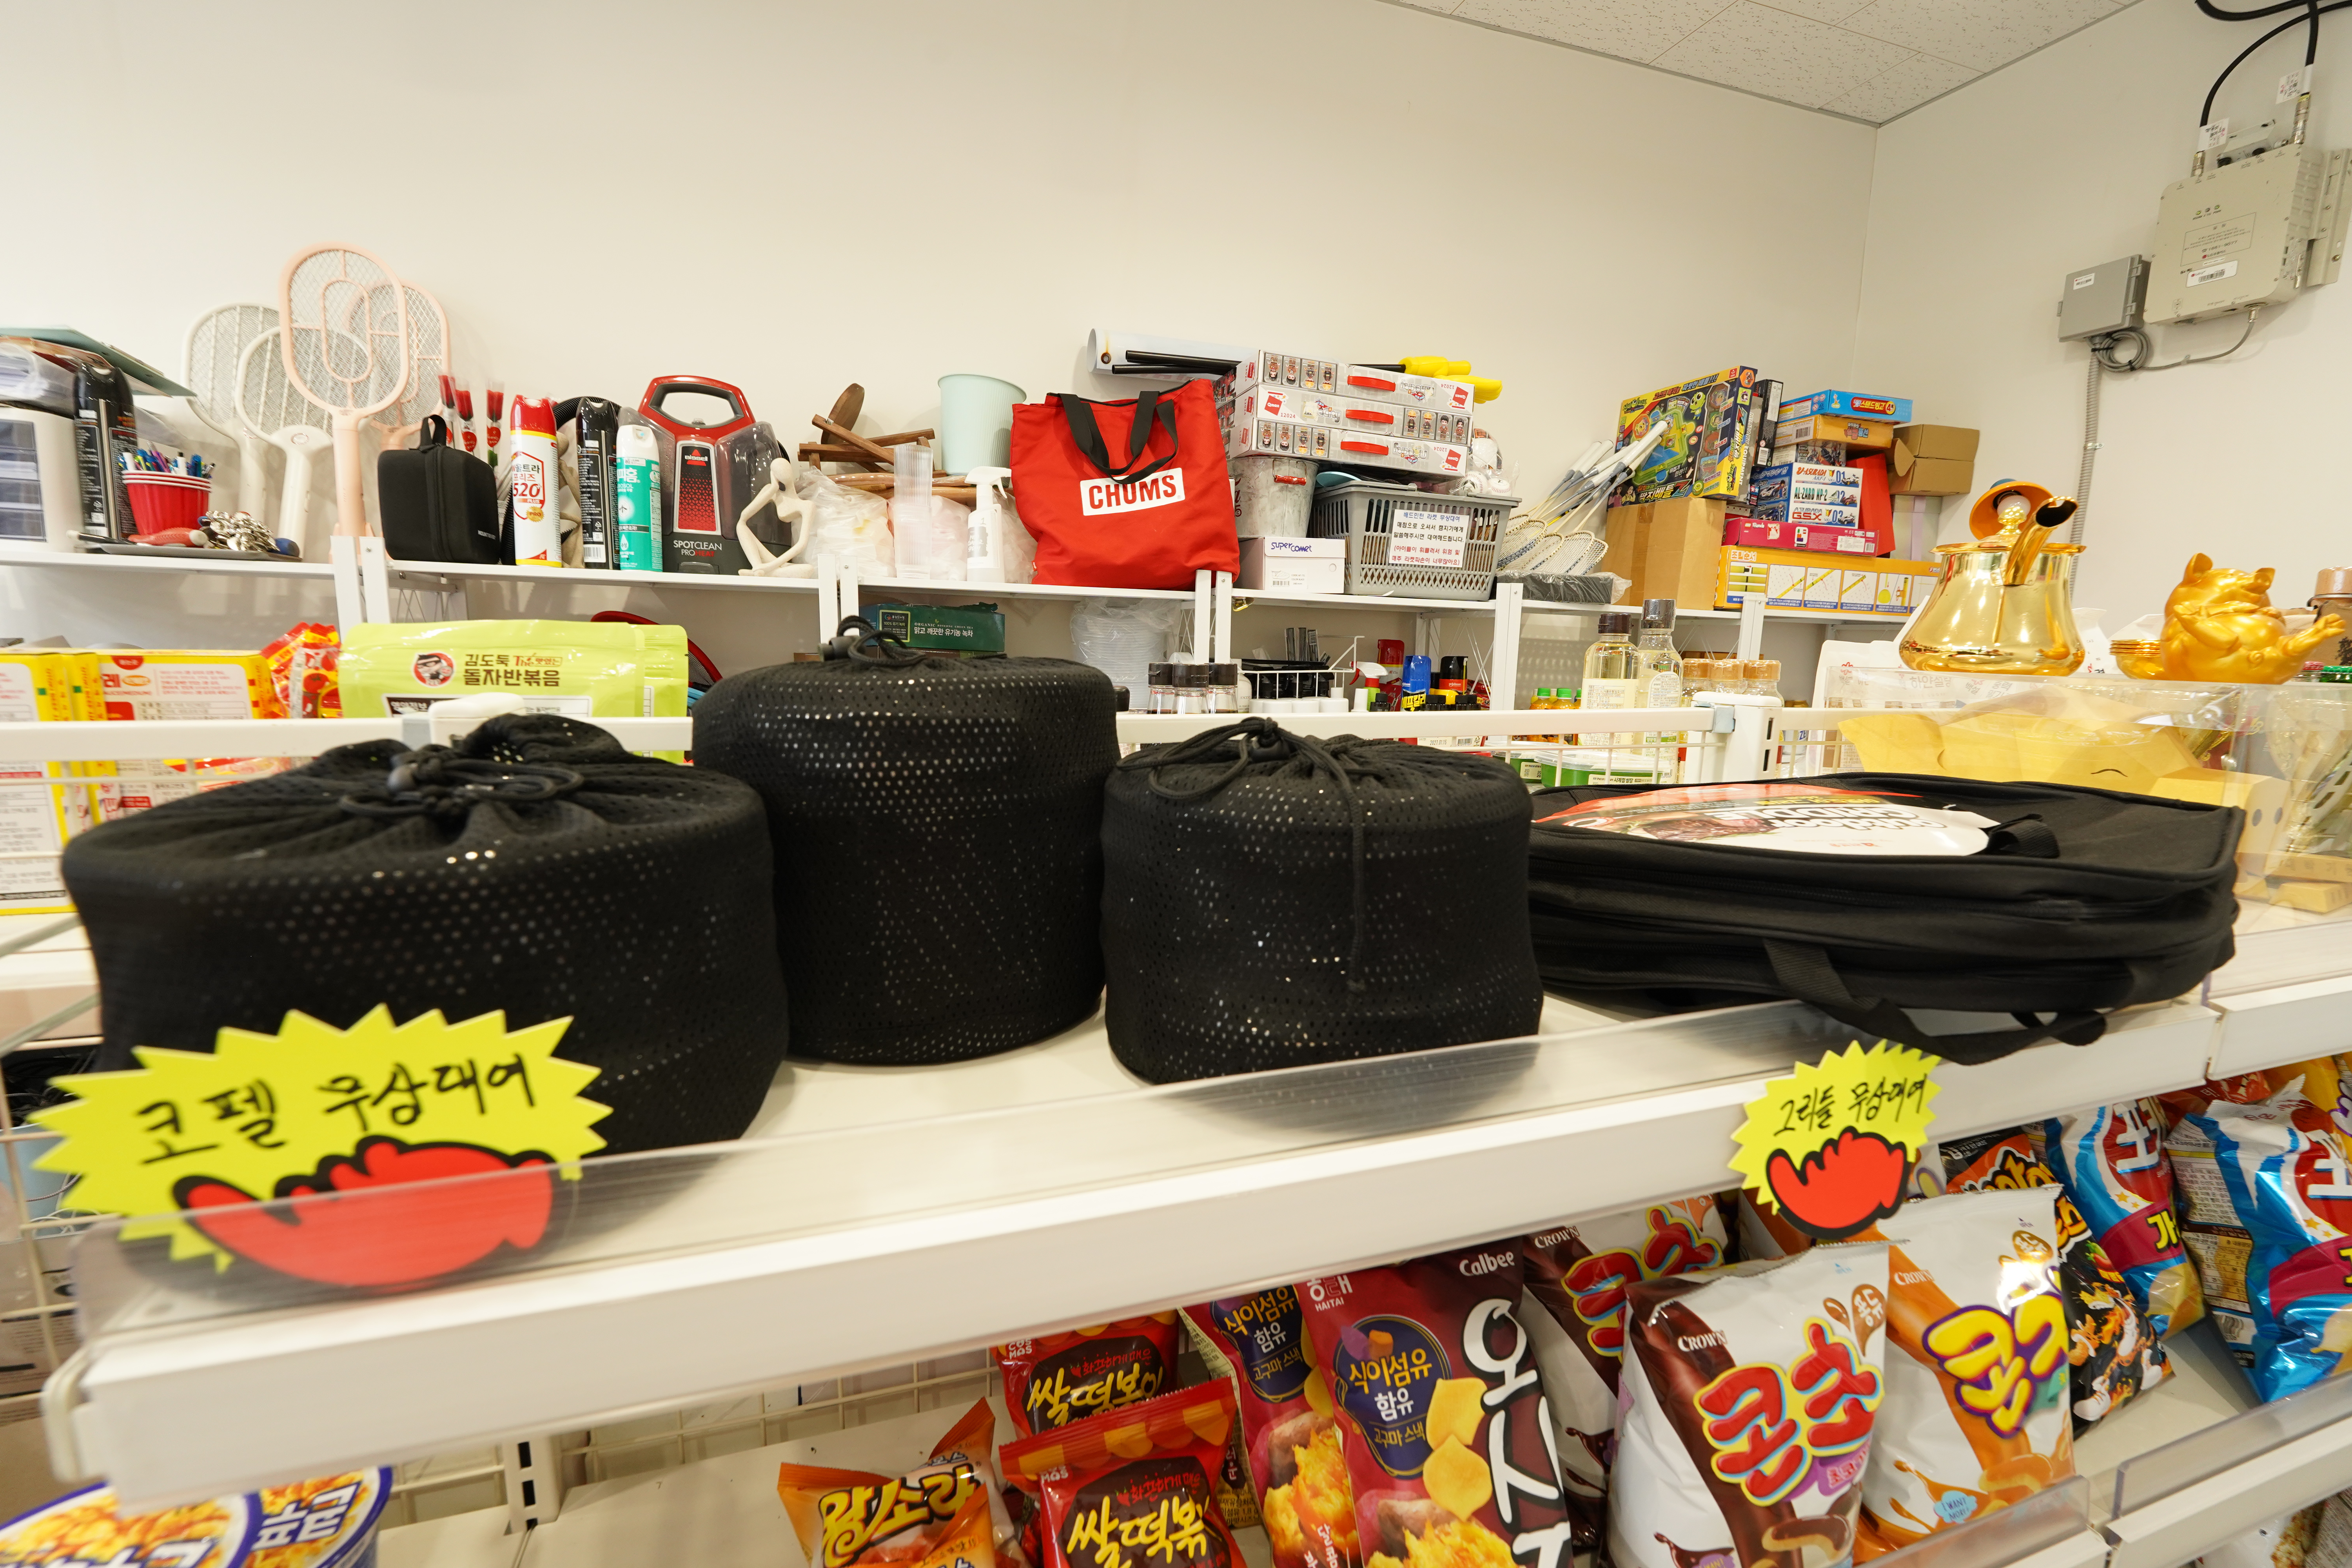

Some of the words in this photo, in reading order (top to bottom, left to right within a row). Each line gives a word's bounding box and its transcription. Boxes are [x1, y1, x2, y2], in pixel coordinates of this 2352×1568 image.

[1739, 445, 1748, 486] EQUIPMENT
[514, 474, 536, 482] 프리즈
[1088, 474, 1177, 510] CHUMS
[1792, 512, 1822, 521] GSX
[673, 540, 722, 550] SPOTCLEAN
[1427, 534, 1464, 543] 대여해드립니다.
[681, 549, 715, 557] PROHEAT
[1731, 550, 1757, 561] 조립순서
[927, 628, 944, 636] 깨끗한
[944, 629, 961, 637] 유기농
[465, 653, 510, 667] 김도둑
[463, 669, 561, 687] 돌자반볶음
[1703, 807, 1918, 820] GRIDDLE
[1767, 817, 1947, 831] outdoor
[136, 1076, 286, 1165] 코펠
[1773, 1084, 1835, 1137] 그리들
[1533, 1226, 1581, 1250] CROWN
[1459, 1252, 1515, 1277] Calbee
[1894, 1269, 1935, 1286] CROWN
[1223, 1287, 1295, 1336] 식이섬유
[1315, 1298, 1344, 1312] HAITAI
[1254, 1322, 1286, 1354] 함유
[1677, 1331, 1728, 1352] CROWN
[1009, 1345, 1033, 1360] MOS
[1082, 1351, 1127, 1377] 화끈하게
[1128, 1348, 1152, 1366] 매운
[1252, 1361, 1282, 1382] 고구마
[1282, 1347, 1304, 1370] 스낵
[1349, 1347, 1432, 1395] 식이섬유
[1374, 1388, 1414, 1422] 함유
[1374, 1427, 1402, 1446] 고구마
[1403, 1423, 1427, 1443] 스낵
[1129, 1472, 1182, 1503] 화끈하게
[1181, 1472, 1201, 1494] 매운
